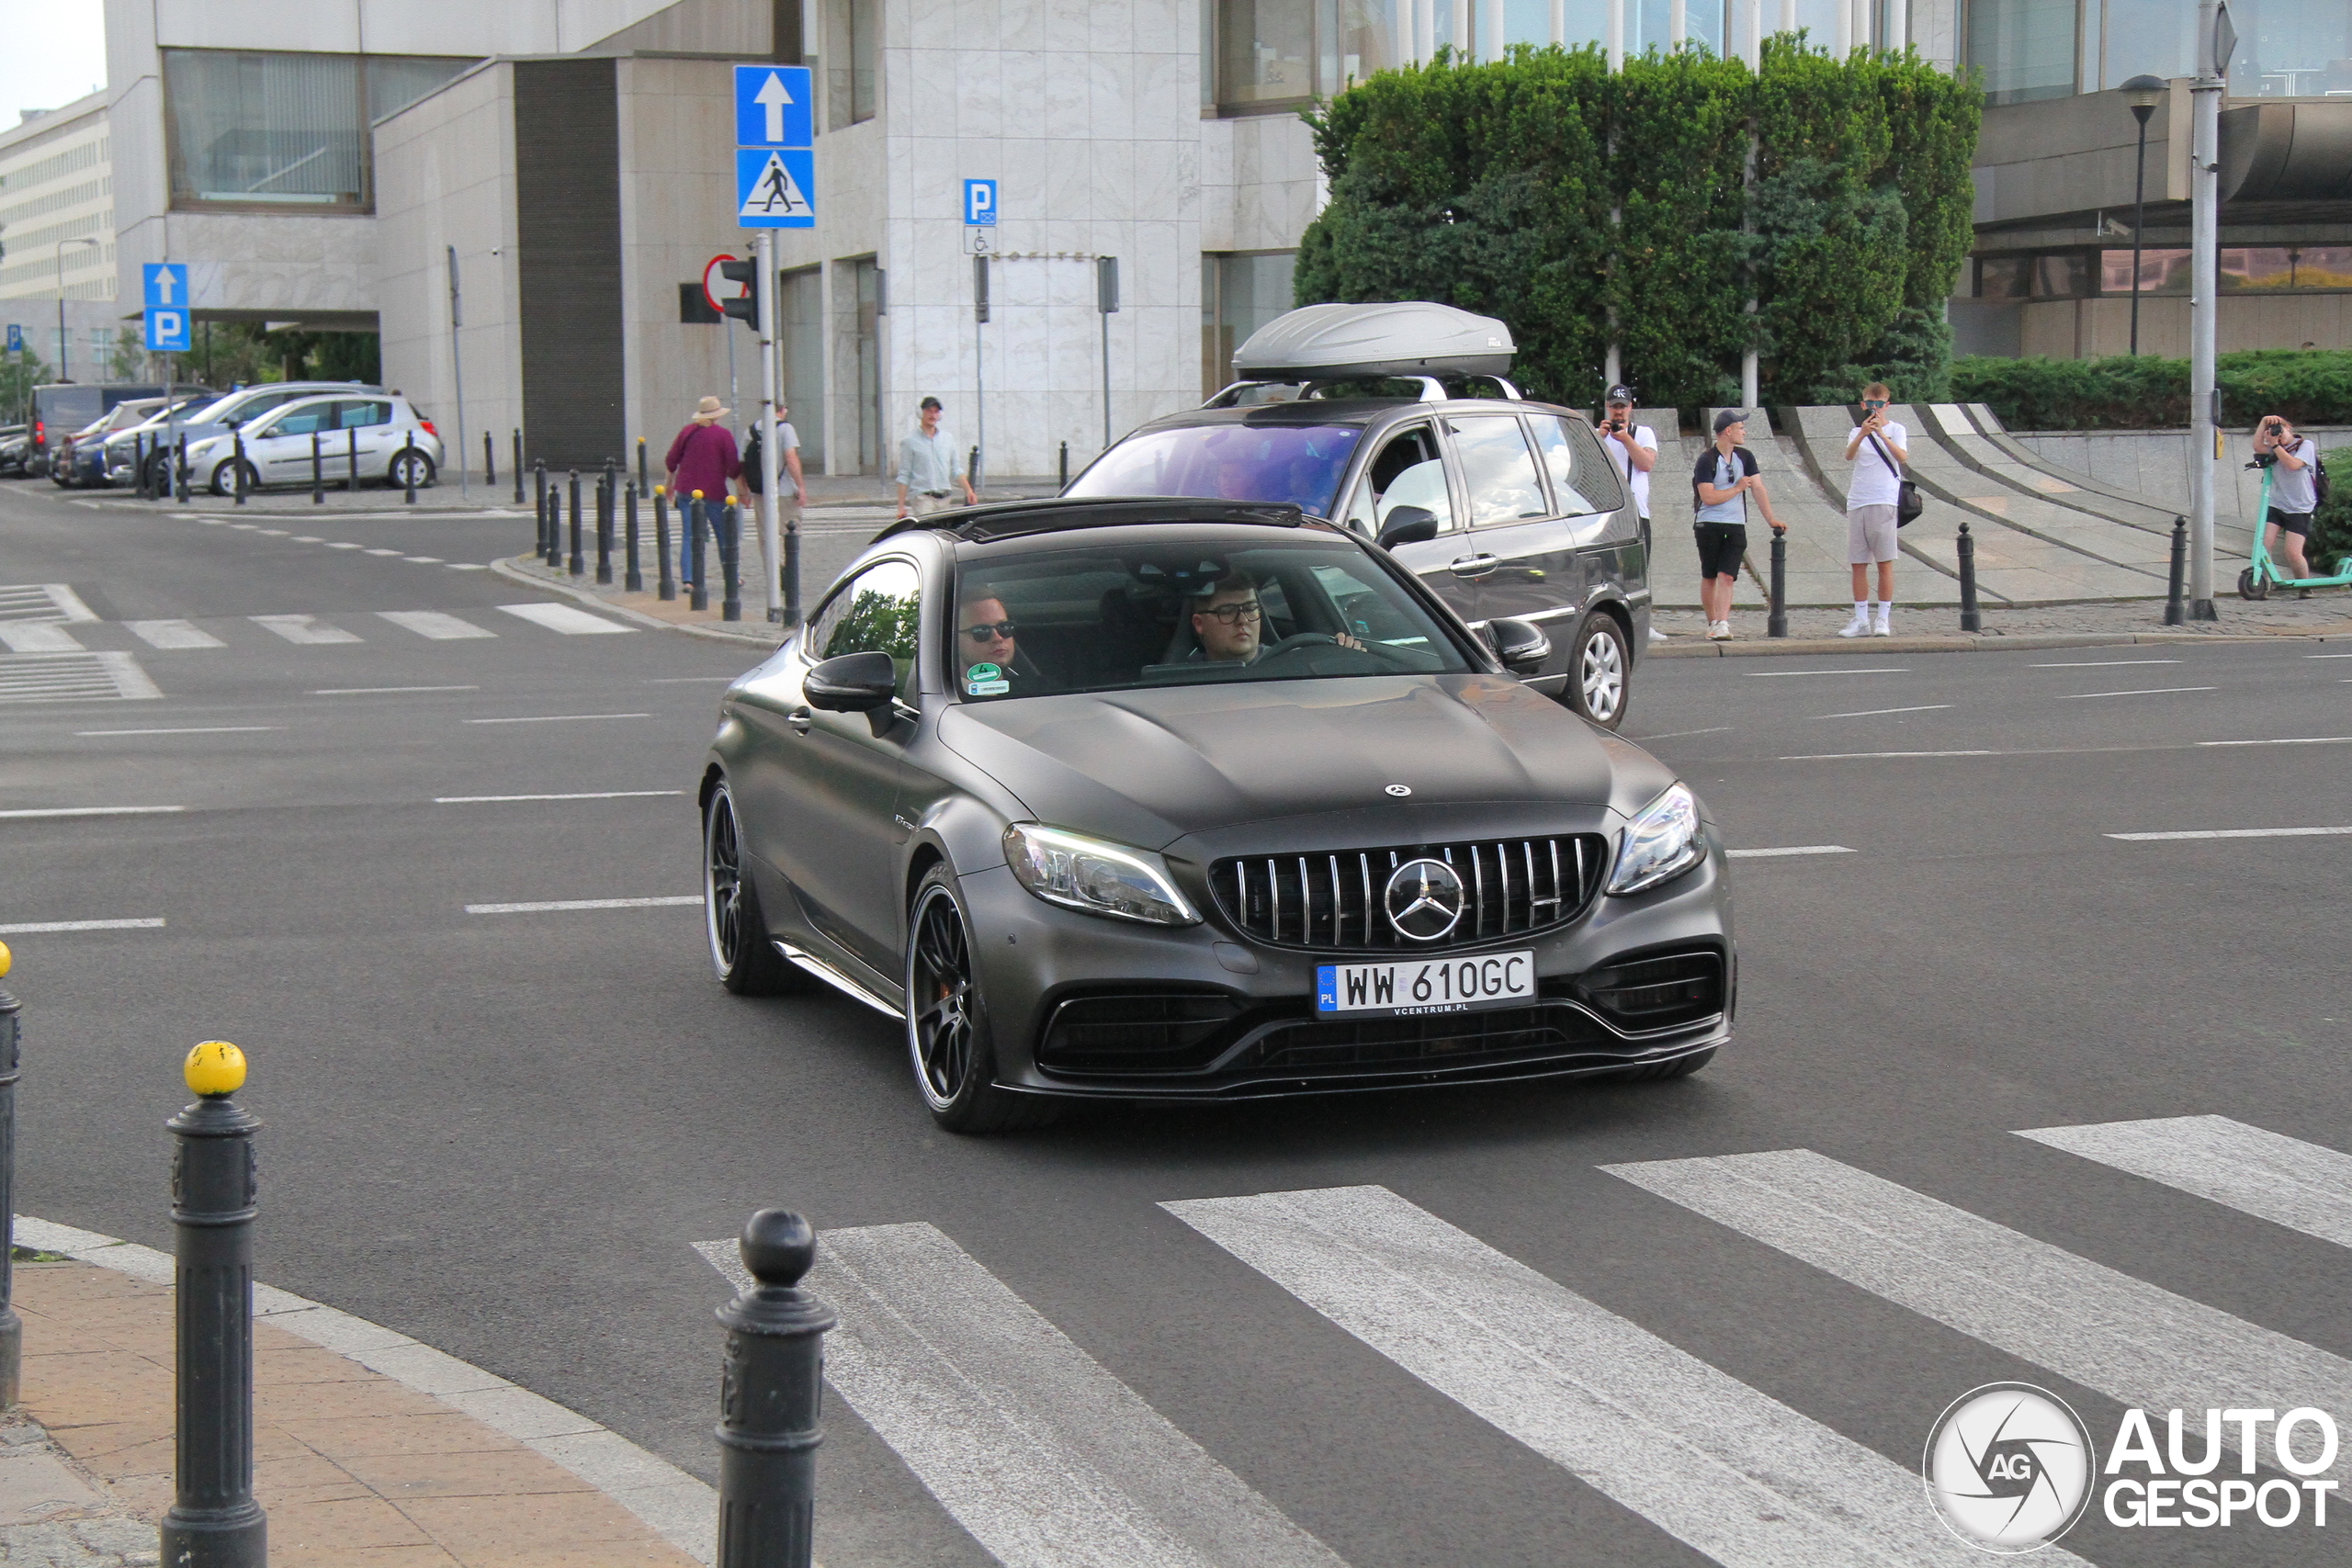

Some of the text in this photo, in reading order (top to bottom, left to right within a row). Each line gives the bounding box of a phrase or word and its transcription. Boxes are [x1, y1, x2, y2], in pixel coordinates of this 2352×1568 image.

[971, 184, 991, 220] P
[154, 311, 182, 346] P
[1346, 956, 1525, 1006] WW 610GC
[1321, 994, 1335, 1004] PL
[1394, 1003, 1469, 1016] VCENTRUM.PL
